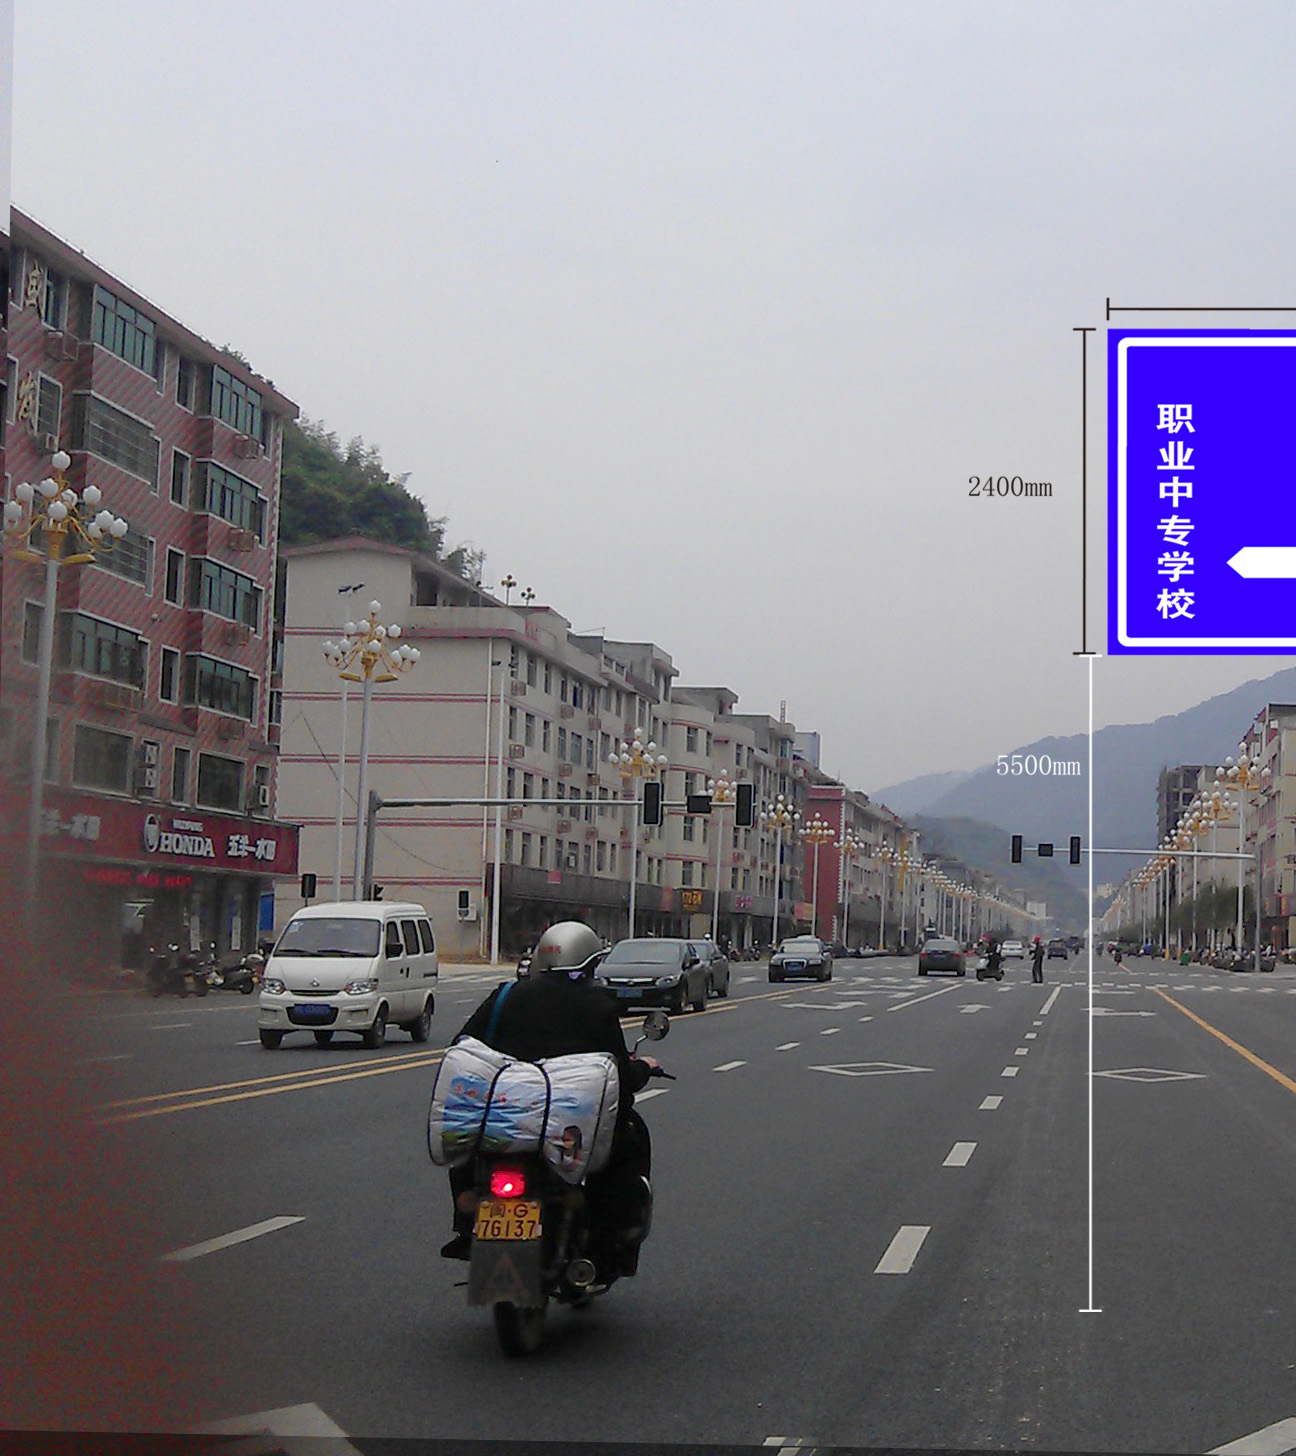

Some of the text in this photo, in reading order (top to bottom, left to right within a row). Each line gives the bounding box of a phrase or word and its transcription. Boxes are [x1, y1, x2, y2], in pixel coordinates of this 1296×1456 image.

[1156, 403, 1196, 620] 职业中专学校
[159, 831, 215, 858] HONDA
